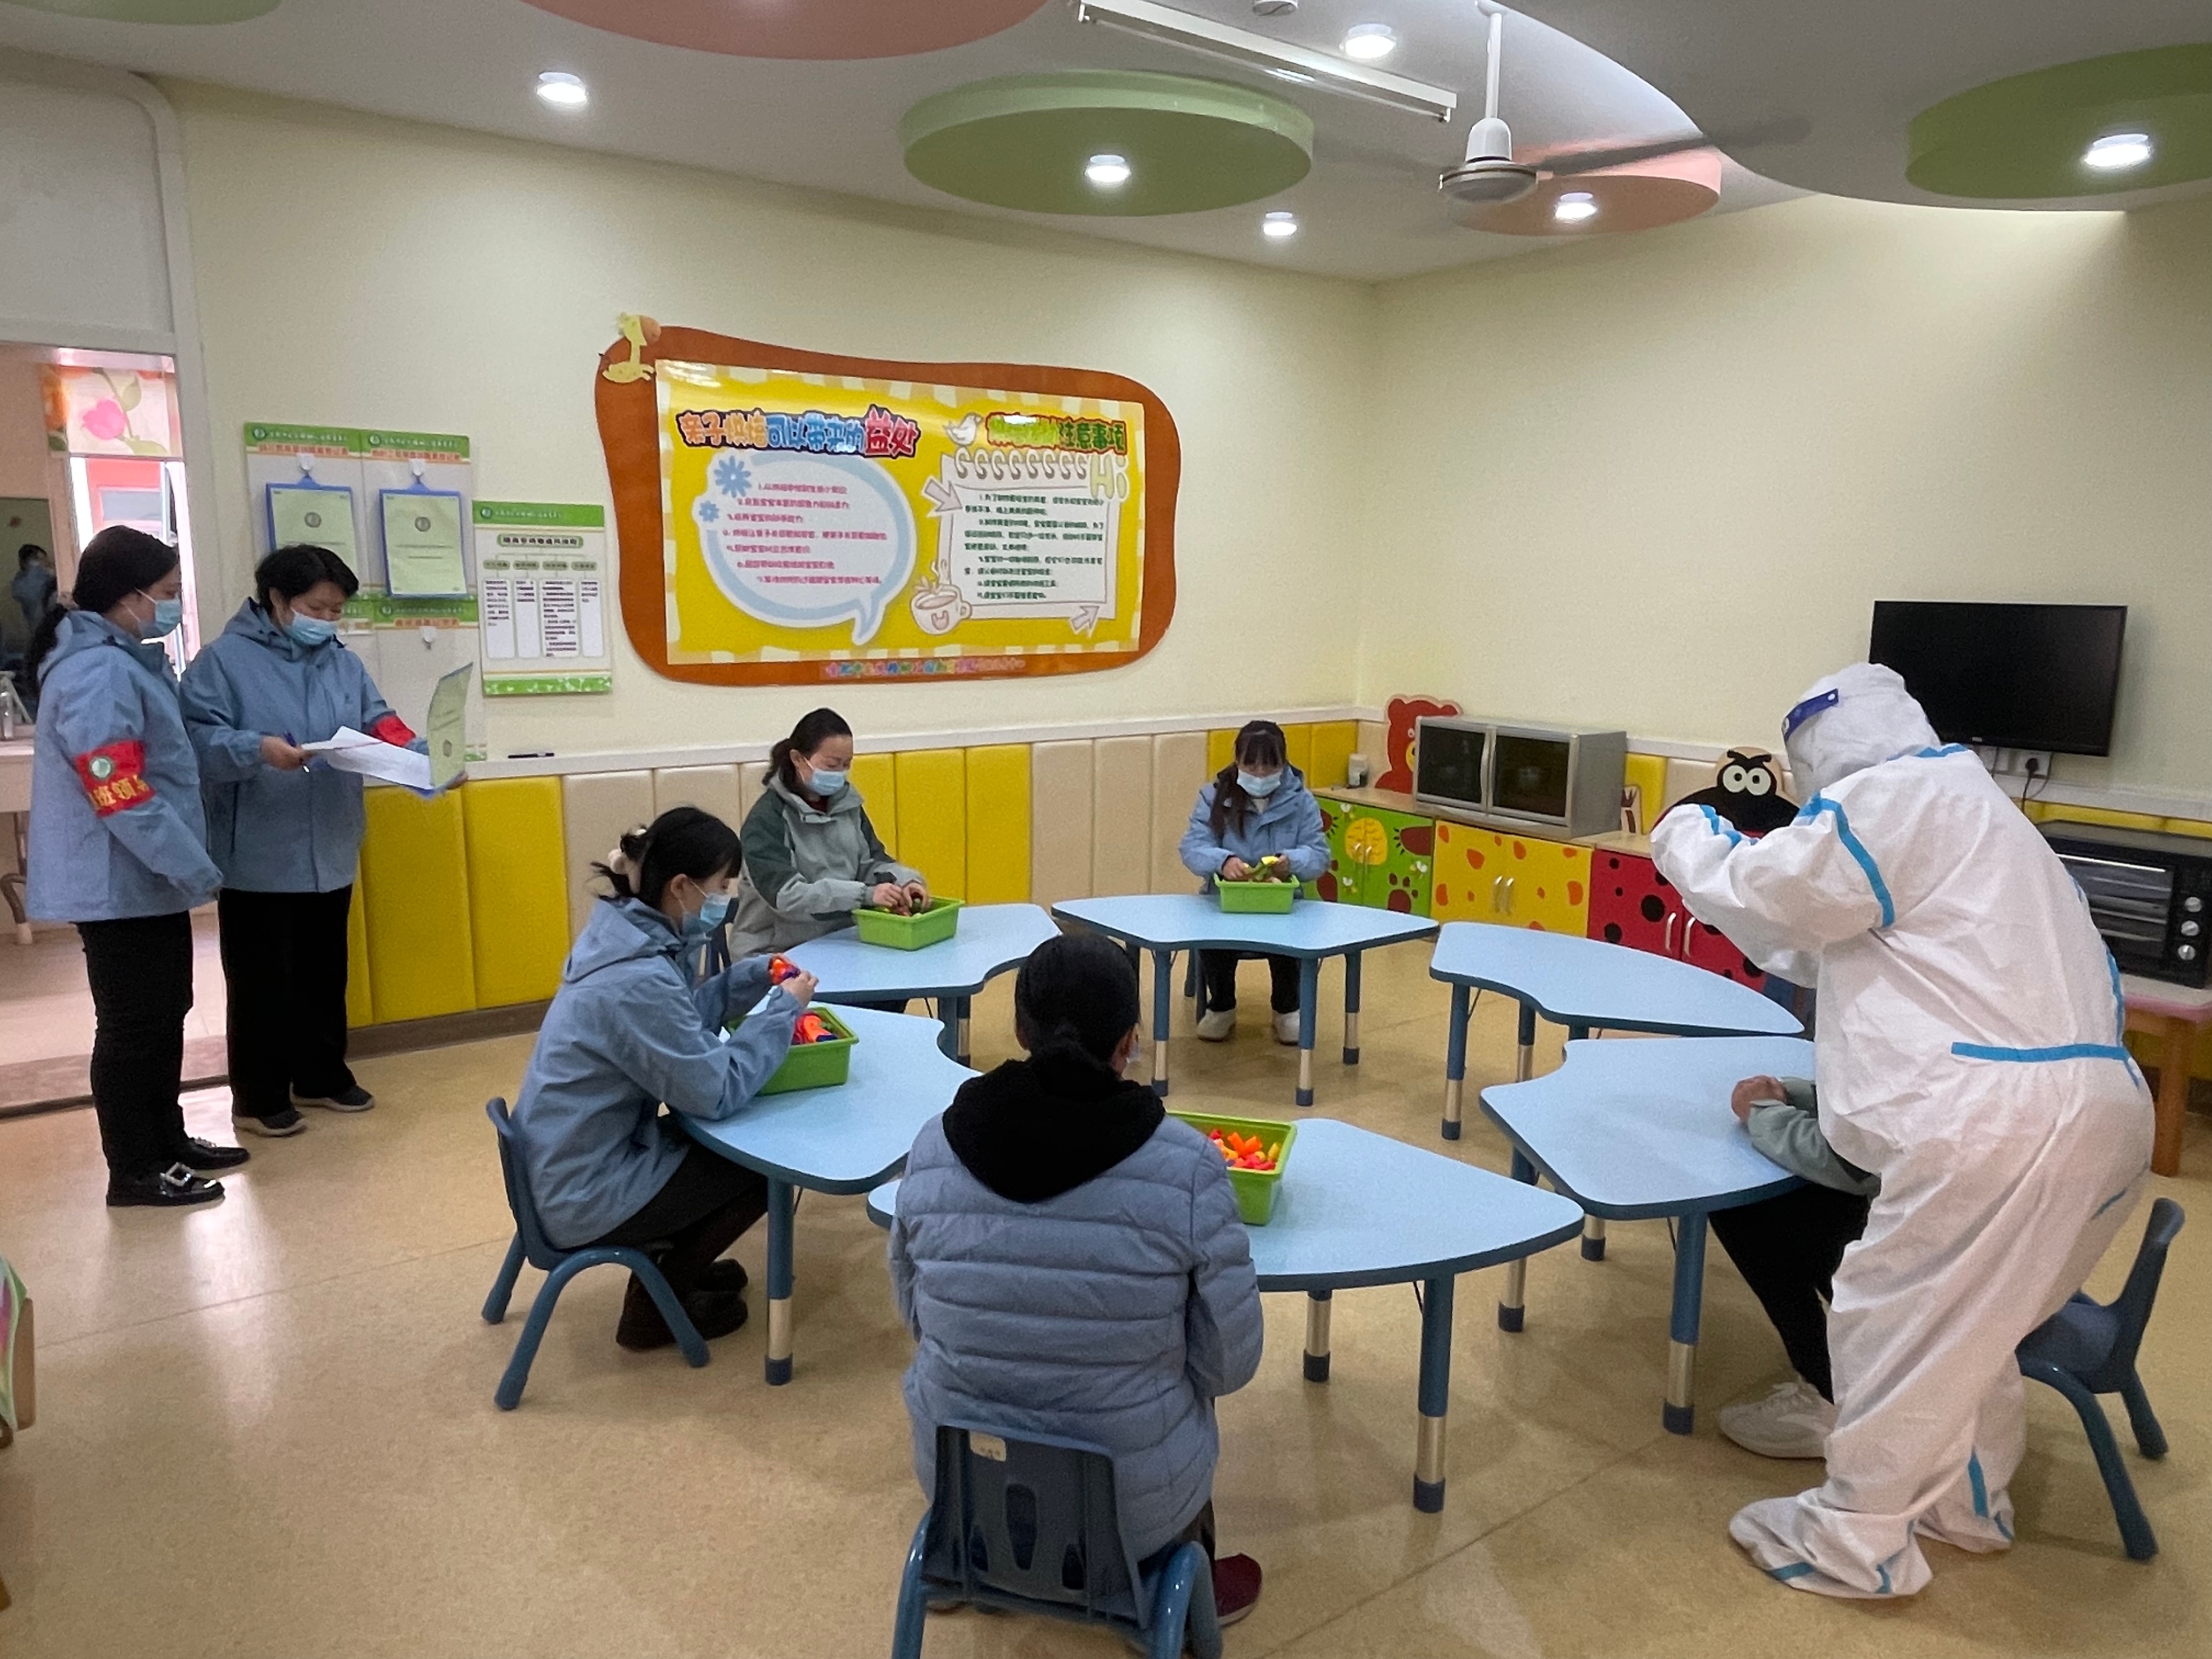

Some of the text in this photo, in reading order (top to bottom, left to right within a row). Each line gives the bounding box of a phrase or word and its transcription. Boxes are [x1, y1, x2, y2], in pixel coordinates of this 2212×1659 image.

[678, 406, 920, 457] 亲子烘焙可以带来的益处
